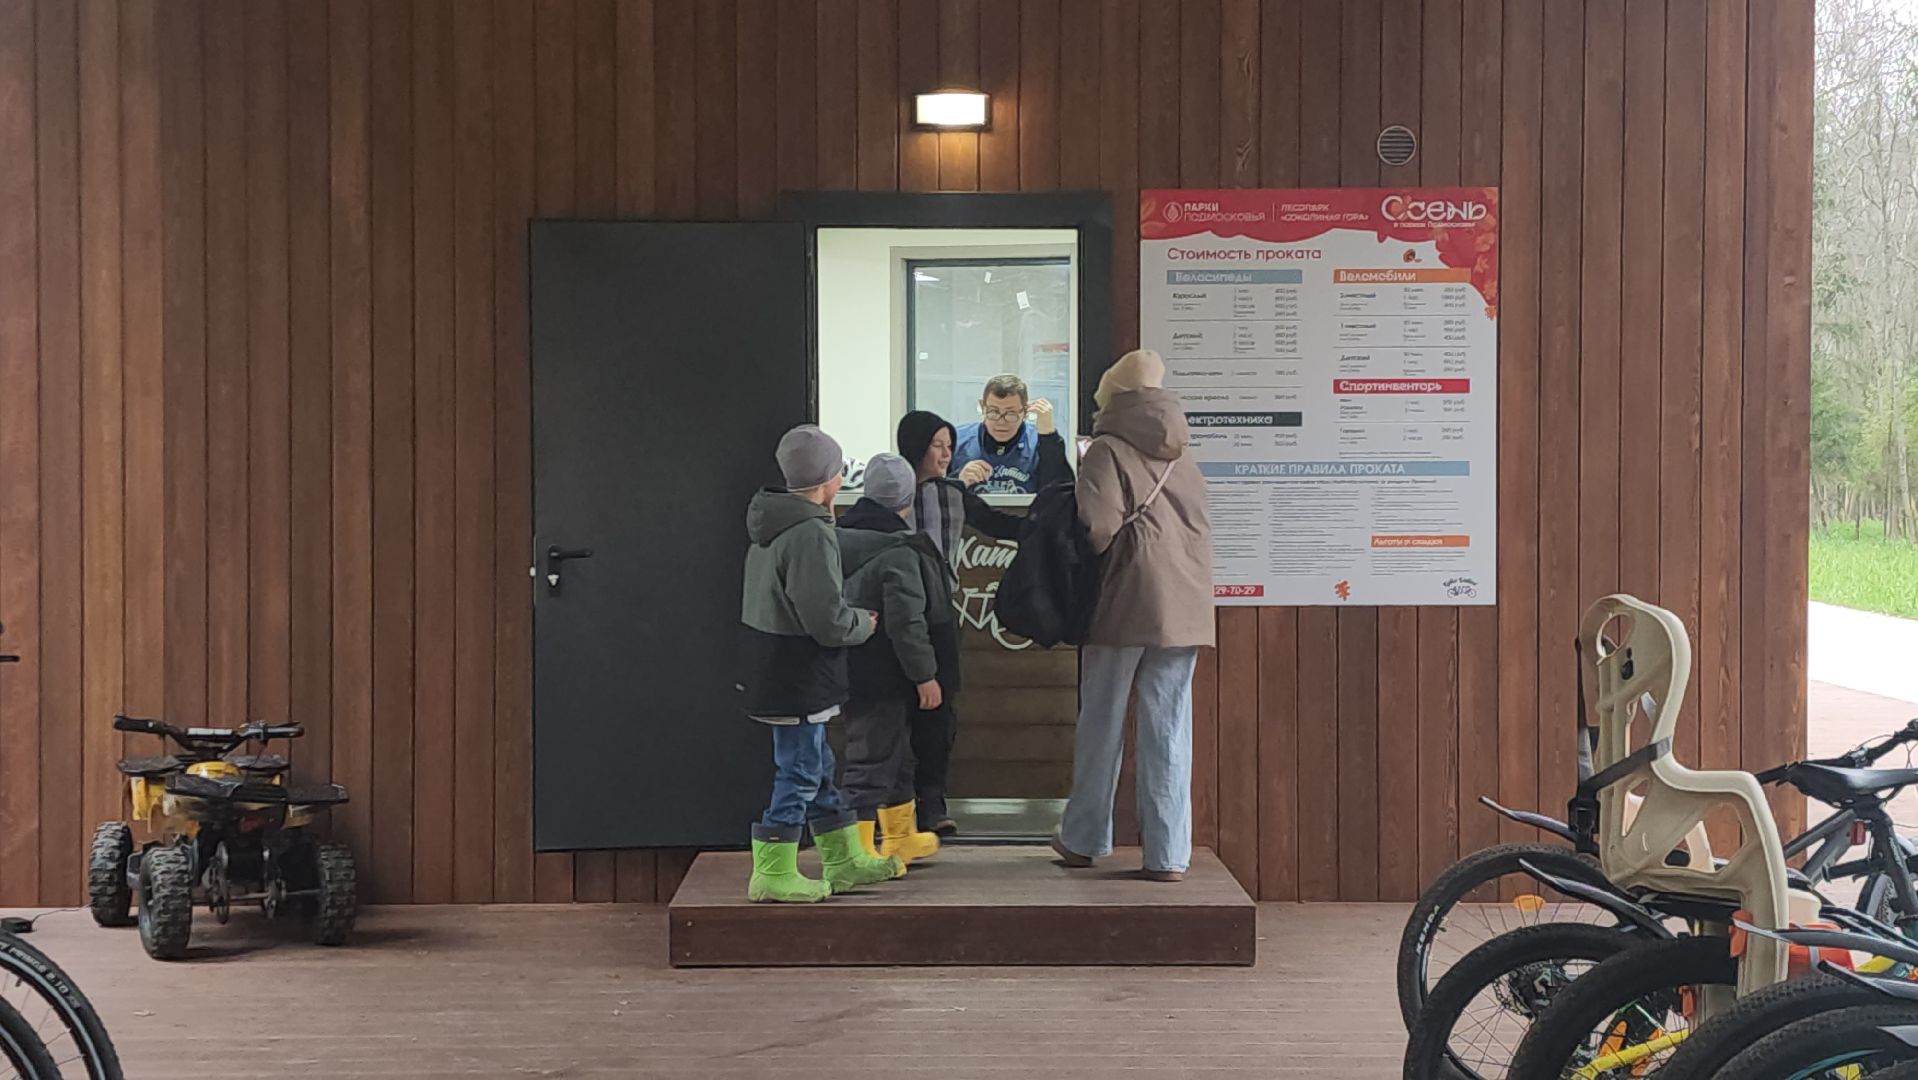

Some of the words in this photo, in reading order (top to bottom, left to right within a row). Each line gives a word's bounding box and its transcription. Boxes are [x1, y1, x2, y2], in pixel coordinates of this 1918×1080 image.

[1184, 202, 1219, 212] ПАРКИ
[1281, 203, 1331, 212] ЛЕСОПАРК
[1184, 212, 1266, 222] ПОДМОСКОВЬЯ
[1167, 248, 1251, 261] Стоимость
[1256, 248, 1322, 262] проката
[1175, 271, 1252, 283] Велосипеды
[1339, 270, 1417, 282] Веломобили
[1188, 414, 1274, 427] ектротехника
[1234, 463, 1286, 475] КРАТКИЕ
[1288, 463, 1346, 475] ПРАВИЛА
[1349, 463, 1406, 475] ПРОКАТА
